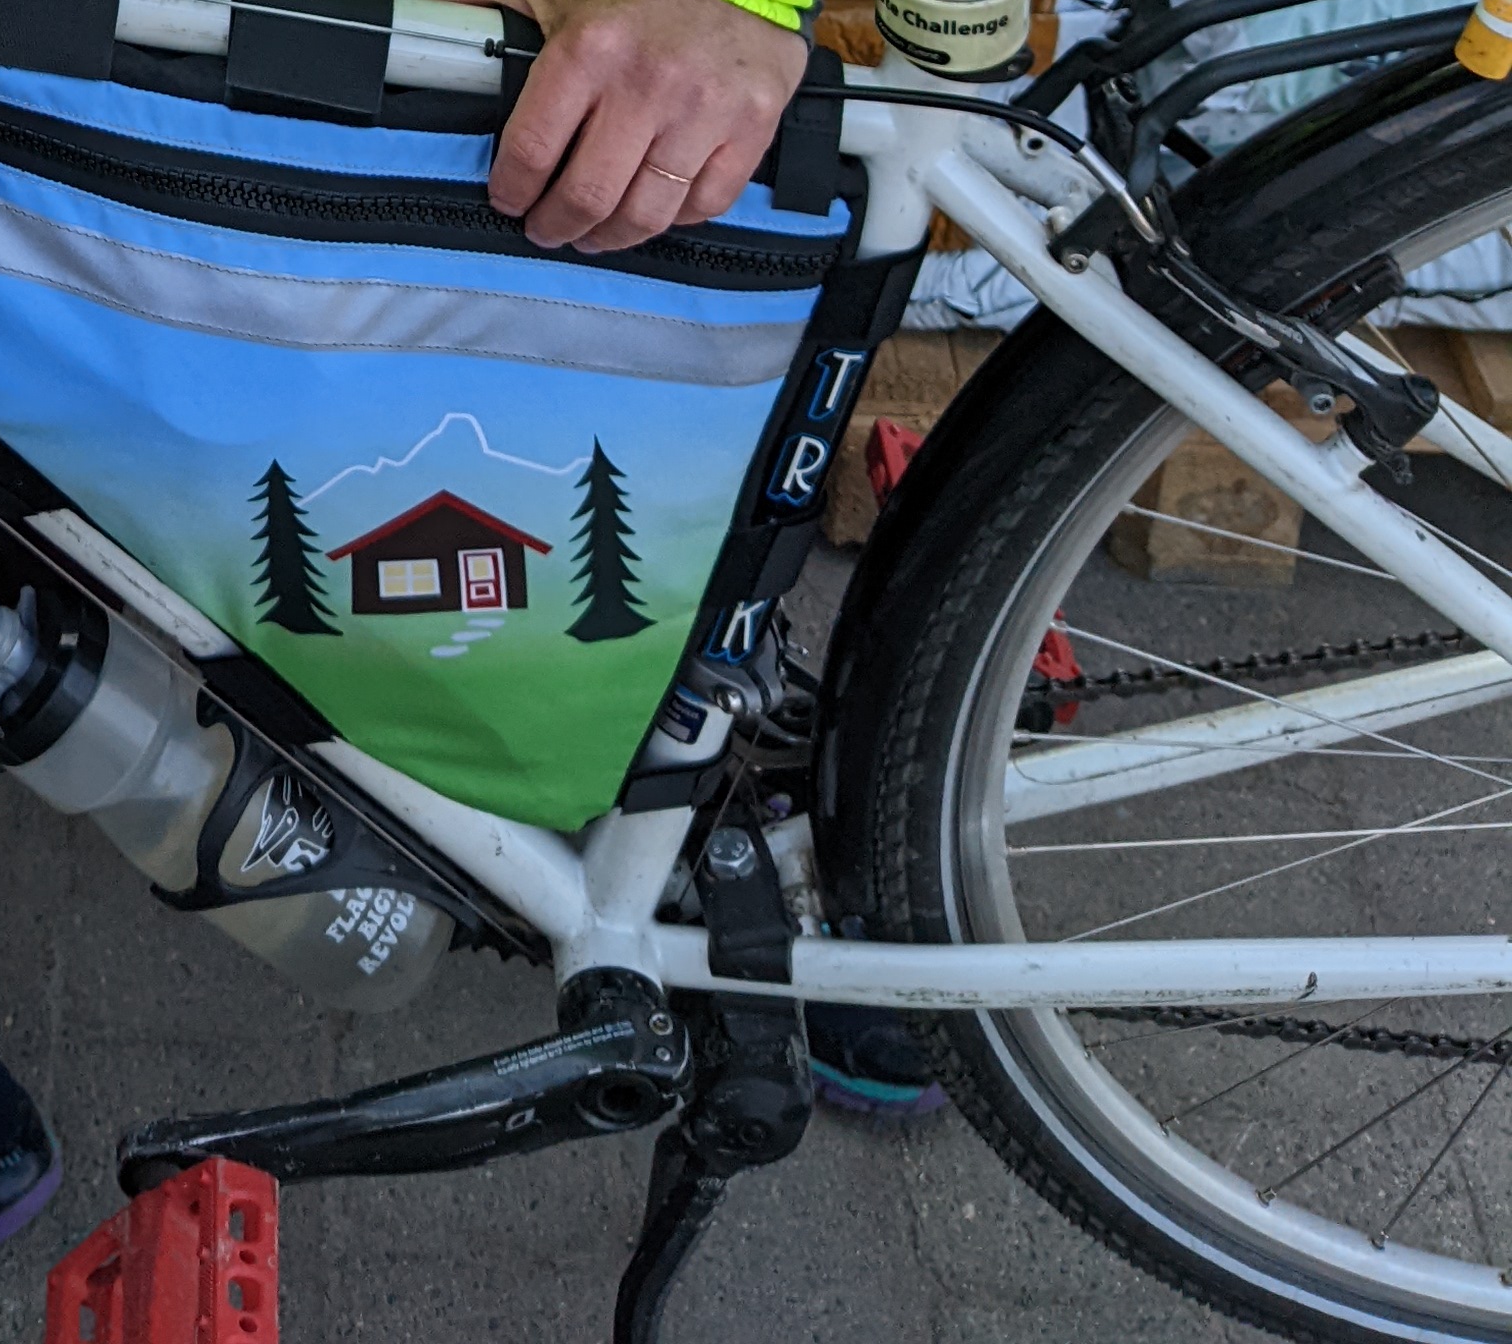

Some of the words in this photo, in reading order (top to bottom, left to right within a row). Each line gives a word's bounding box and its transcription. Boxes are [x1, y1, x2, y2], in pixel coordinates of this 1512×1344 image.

[902, 8, 1009, 36] Challenge
[710, 350, 866, 658] TRK
[357, 892, 416, 974] REVOL
